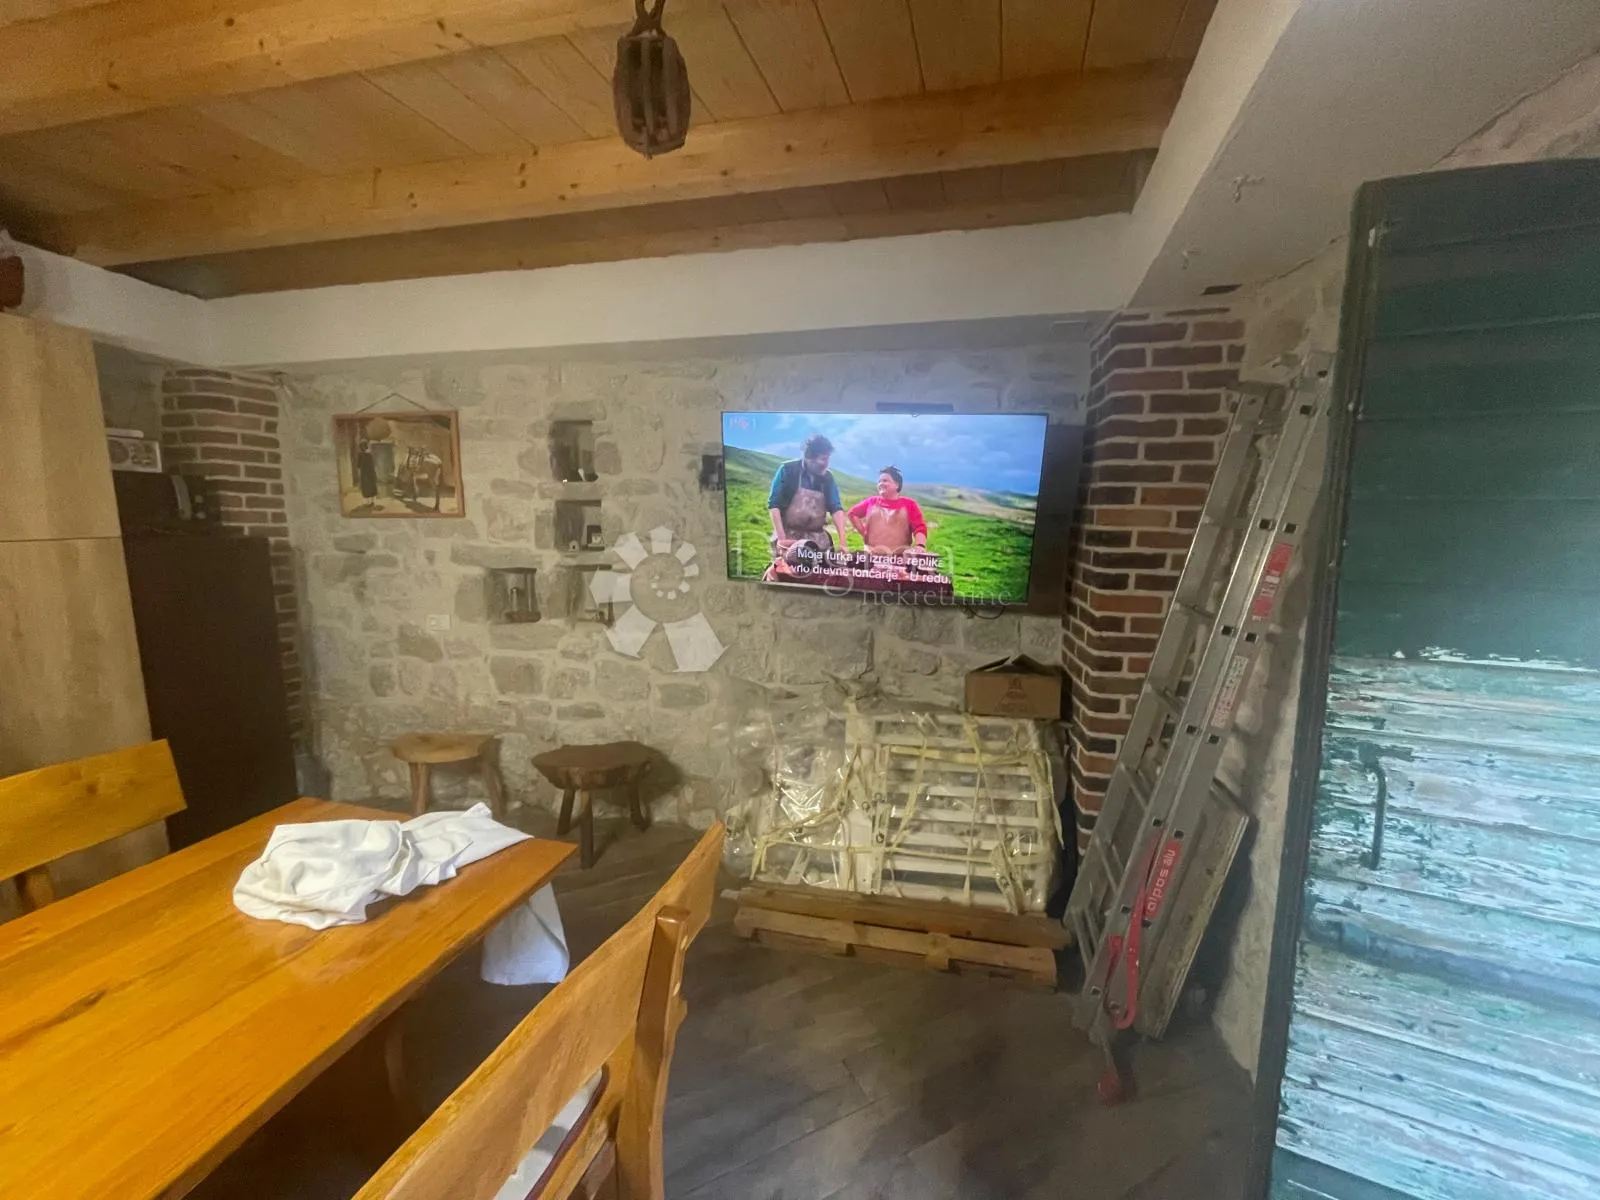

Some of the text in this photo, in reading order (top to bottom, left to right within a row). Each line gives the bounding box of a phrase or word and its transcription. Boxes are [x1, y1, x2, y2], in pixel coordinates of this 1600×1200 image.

[797, 548, 823, 560] Moja
[826, 549, 853, 562] furka
[856, 552, 867, 564] je
[869, 554, 904, 565] izrada
[813, 565, 850, 577] drevne
[1147, 849, 1176, 912] alpos alu
